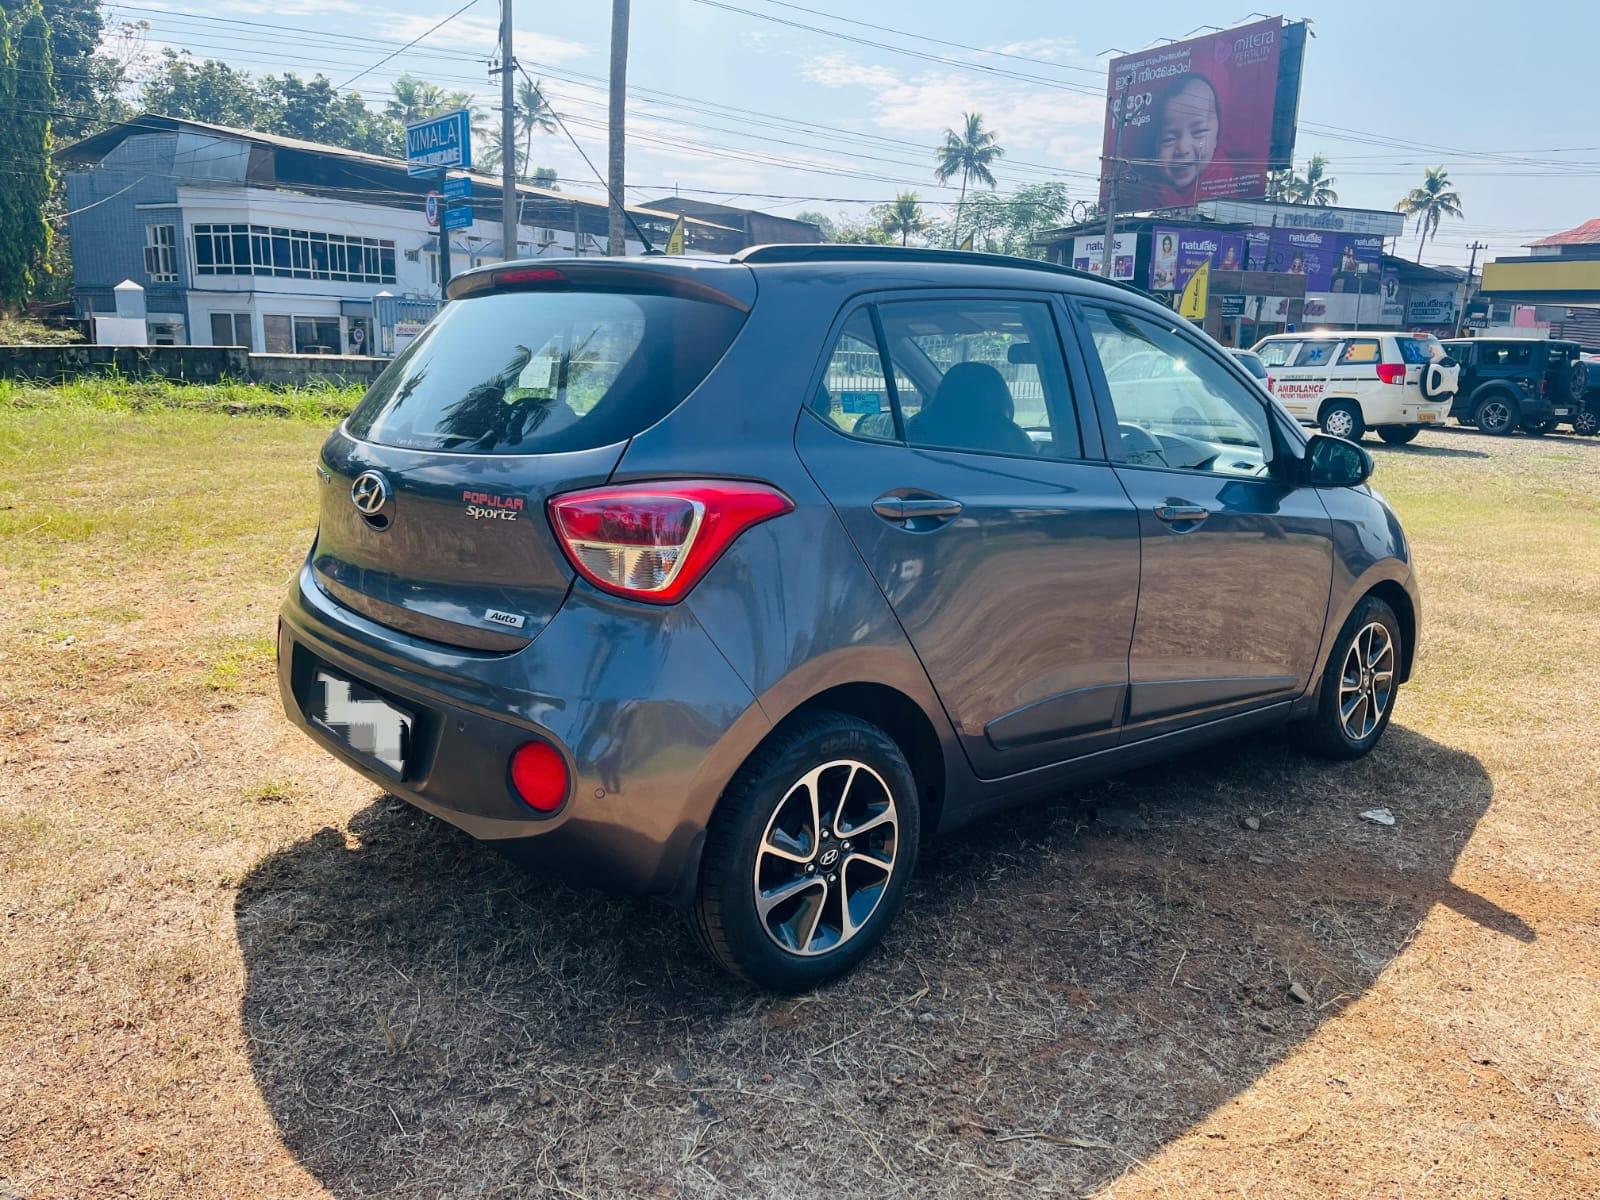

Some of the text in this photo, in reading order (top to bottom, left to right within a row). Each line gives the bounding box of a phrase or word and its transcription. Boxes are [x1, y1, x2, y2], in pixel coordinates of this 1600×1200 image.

[1235, 45, 1272, 60] FERTILITY
[408, 121, 457, 153] VIMALA
[1289, 232, 1323, 244] naturals
[1181, 240, 1217, 251] naturals
[1463, 318, 1486, 328] Bata
[1277, 384, 1324, 393] AMBULANCE
[463, 490, 524, 511] POPULAR
[466, 505, 517, 521] Sportz
[490, 612, 517, 624] Auto
[820, 731, 866, 754] apollo
